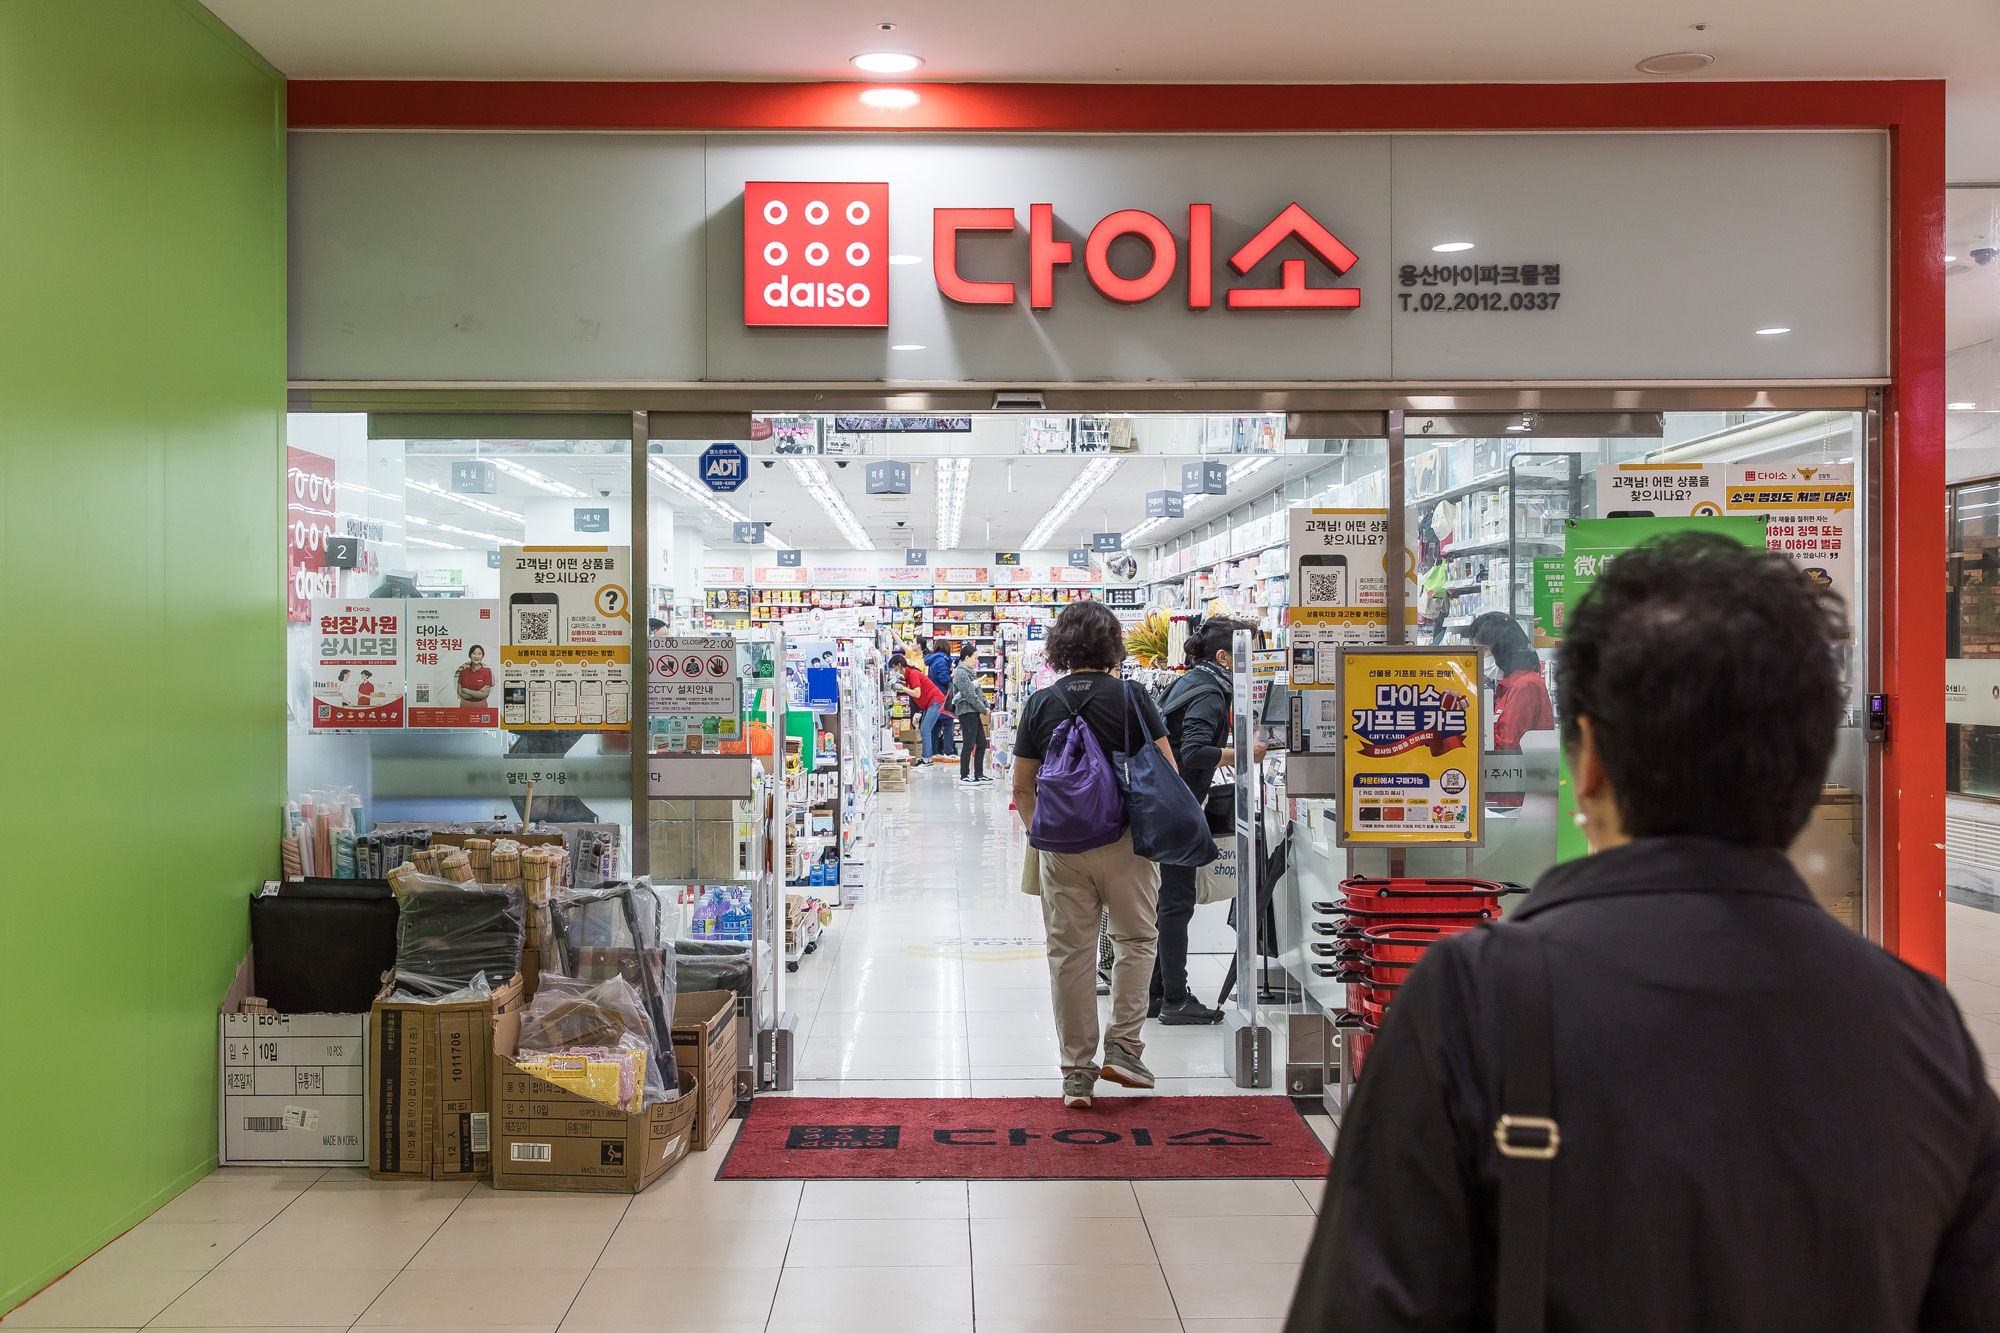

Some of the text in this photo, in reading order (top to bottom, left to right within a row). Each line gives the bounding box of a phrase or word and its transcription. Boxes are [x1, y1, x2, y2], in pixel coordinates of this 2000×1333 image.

[932, 201, 1362, 310] 다이소
[1399, 263, 1561, 287] 용산아이파크몰점
[763, 274, 871, 308] daiso
[1398, 291, 1562, 313] T.02.2012.0337
[706, 459, 741, 477] ADT
[1612, 475, 1710, 489] 고객님! 어떤 상품을
[1757, 471, 1788, 480] 다이소
[1631, 490, 1692, 502] 찾으시나요?
[1730, 491, 1852, 503] 소액 범죄도 처벌 대상!
[1305, 520, 1341, 532] 고객님!
[1345, 520, 1366, 532] 어떤
[1797, 525, 1819, 537] 징역
[1821, 525, 1843, 536] 또는
[1323, 534, 1385, 546] 찾으시나요?
[1785, 539, 1842, 551] 이하의 벌금
[337, 545, 347, 560] 2
[515, 558, 615, 570] 고객님! 어떤 상품을
[534, 571, 597, 584] 찾으시나요?
[320, 615, 398, 635] 현장사원
[416, 624, 449, 637] 다이소
[320, 637, 397, 657] 상시모집
[416, 638, 463, 651] 현장 직원
[703, 639, 734, 649] 22:00
[416, 652, 439, 666] 채용
[1368, 669, 1392, 678] 선물용
[1394, 669, 1417, 678] 기프트
[1419, 669, 1435, 678] 카드
[677, 685, 714, 695] 설치안내
[1376, 684, 1441, 707] 다이소
[1353, 710, 1466, 732] 기프트 카드
[506, 772, 528, 785] 열린
[546, 771, 568, 785] 이용
[1490, 768, 1523, 779] 주시기
[1359, 776, 1424, 785] 카운터에서 구매가능
[258, 1041, 278, 1062] 10입
[451, 1032, 463, 1082] 1011706
[227, 1072, 253, 1090] 제조일자
[297, 1072, 321, 1090] 유통기한
[532, 1104, 549, 1116] 10입
[504, 1121, 528, 1134] 제조일자
[567, 1121, 591, 1136] 유통기한
[322, 1135, 359, 1146] MADE IN KOREA
[931, 1127, 1273, 1146] 다이소
[581, 1166, 599, 1175] MADE
[605, 1166, 625, 1175] CHINA
